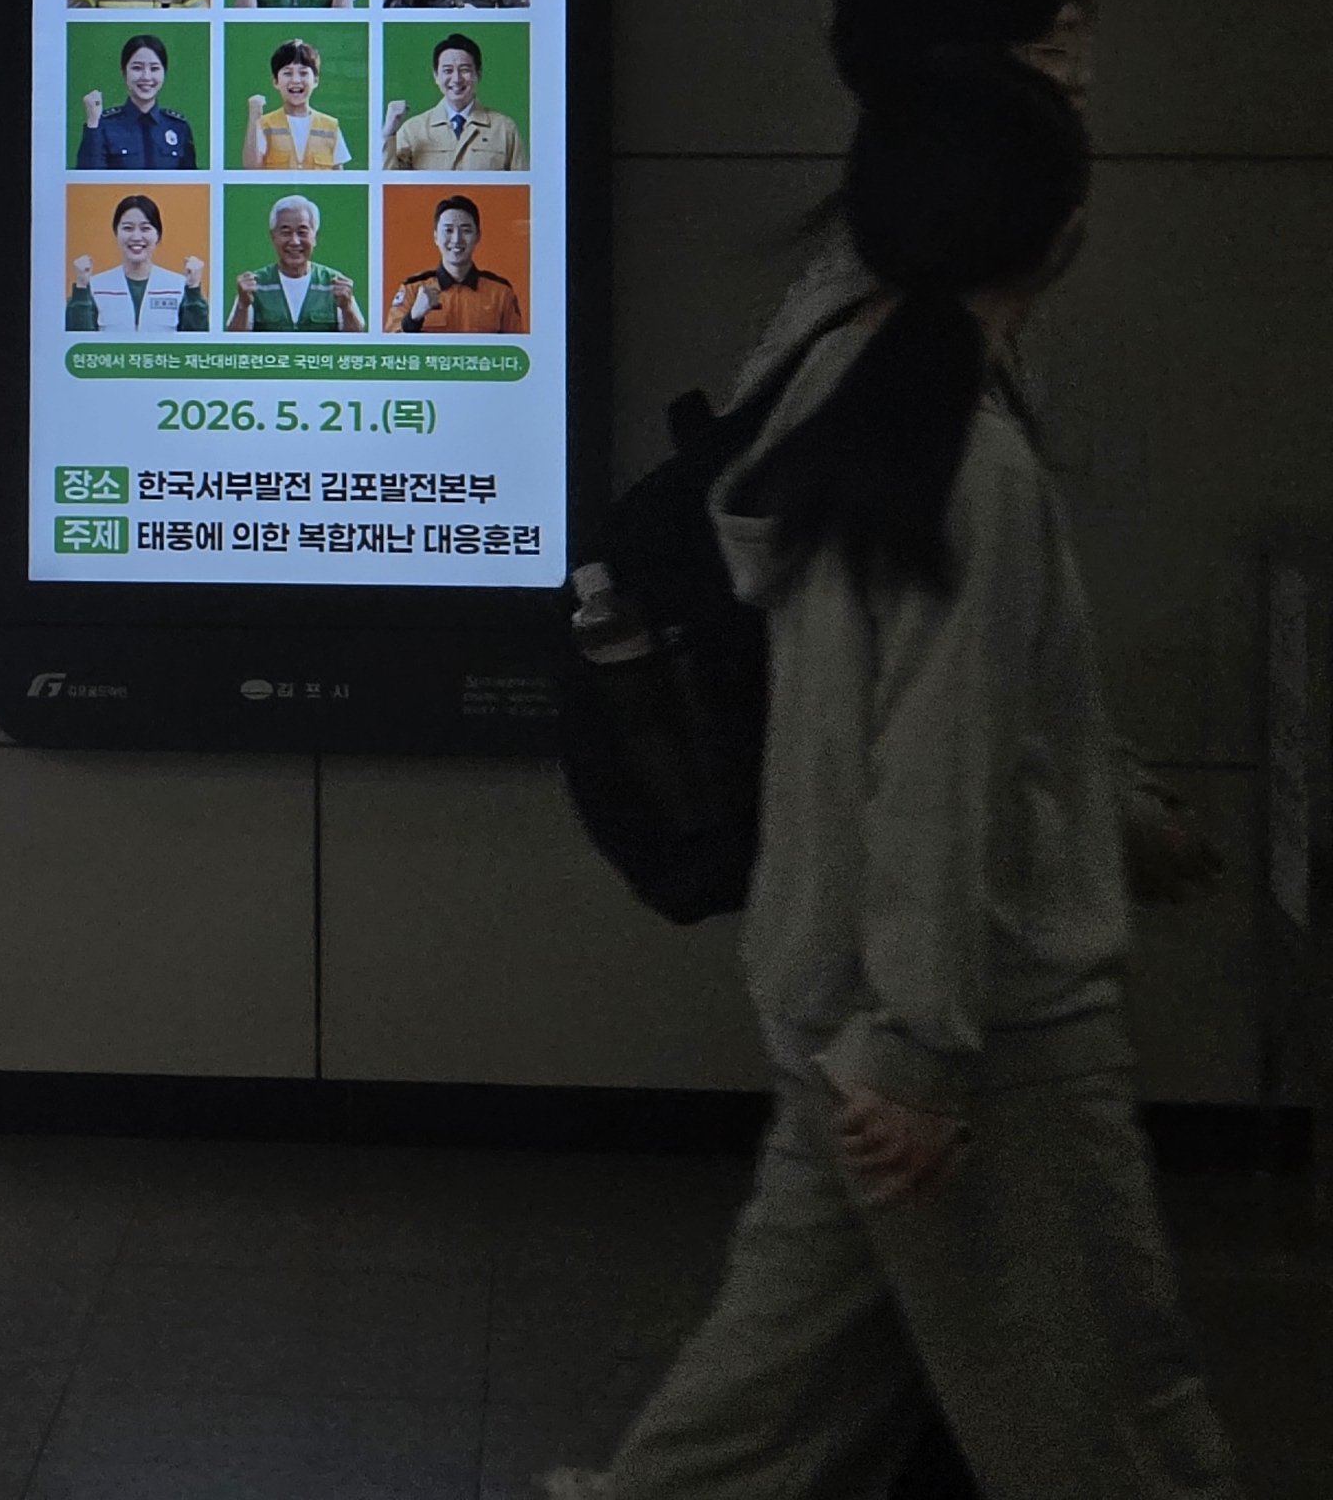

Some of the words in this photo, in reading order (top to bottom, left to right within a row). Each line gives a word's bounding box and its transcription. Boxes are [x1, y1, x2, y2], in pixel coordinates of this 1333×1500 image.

[72, 353, 125, 370] 현장에서
[129, 353, 180, 370] 작동하는
[184, 353, 290, 370] 재난대비훈련으로
[293, 353, 333, 370] 국민의
[337, 354, 377, 370] 생명과
[381, 354, 420, 370] 재산을
[425, 354, 522, 371] 책임지겠습니다.
[157, 400, 265, 431] 2026.
[275, 401, 310, 431] 5.
[320, 400, 436, 434] 21.(목)
[63, 469, 121, 500] 장소
[138, 470, 311, 501] 한국서부발전
[321, 472, 497, 504] 김포발전본부
[63, 520, 120, 551] 주제
[138, 521, 223, 552] 태풍에
[233, 521, 289, 552] 의한
[298, 522, 414, 554] 복합재난
[424, 523, 540, 555] 대응훈련
